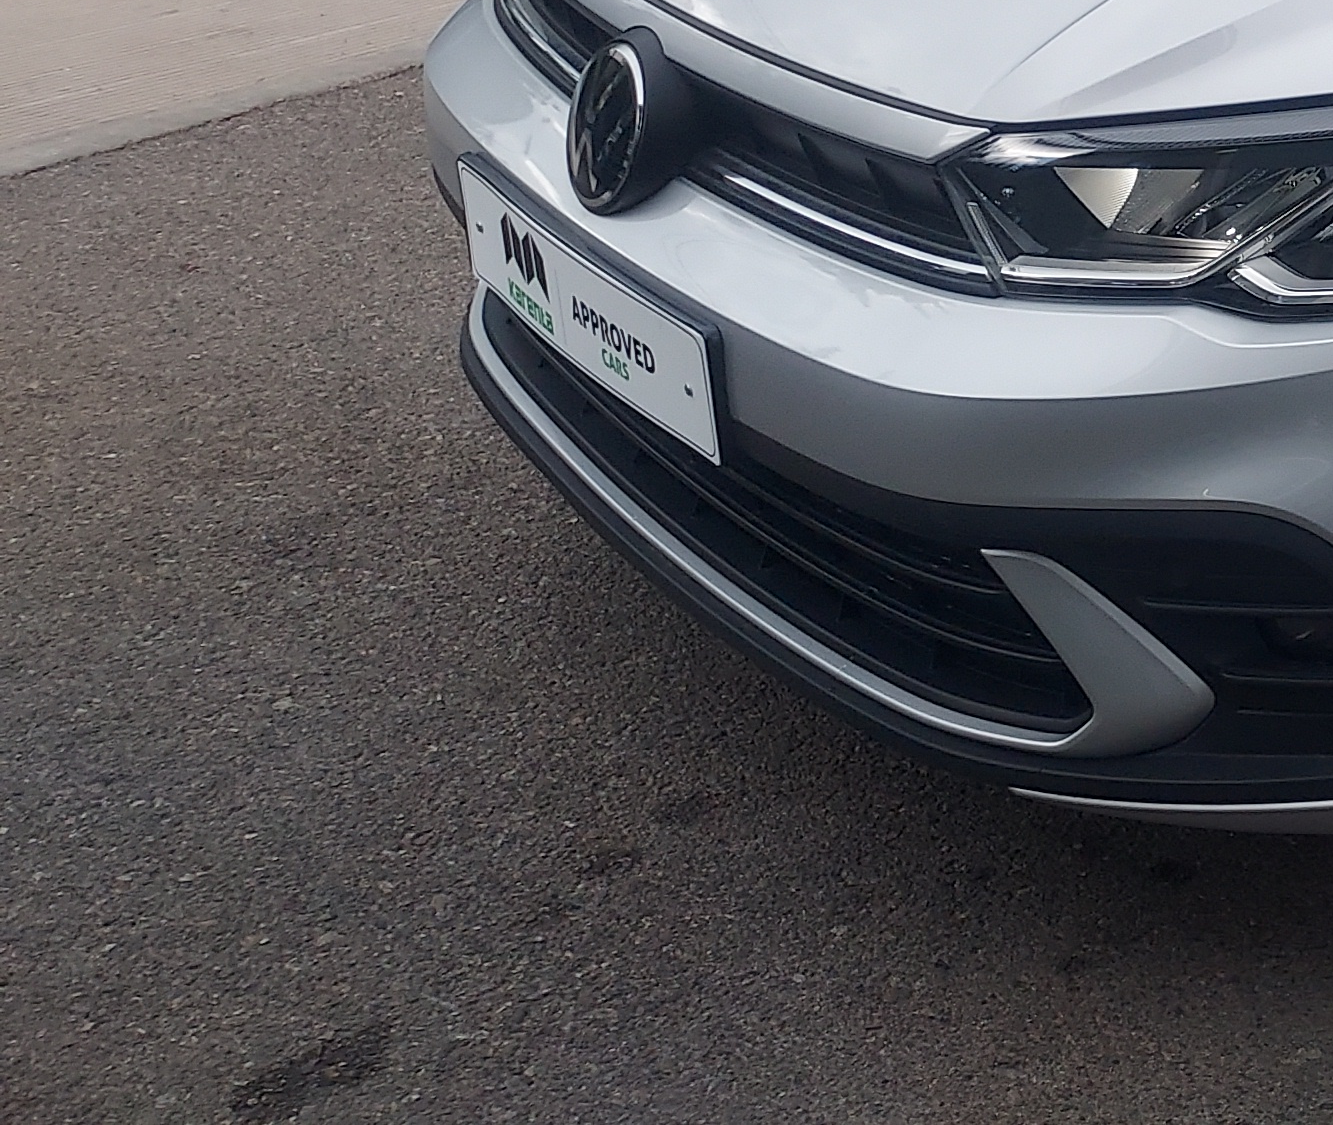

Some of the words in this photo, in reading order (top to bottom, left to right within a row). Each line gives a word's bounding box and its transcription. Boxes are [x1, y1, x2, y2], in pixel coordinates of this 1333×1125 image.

[508, 276, 555, 336] karenta
[572, 295, 656, 374] APPROVED
[601, 348, 630, 381] CARS
